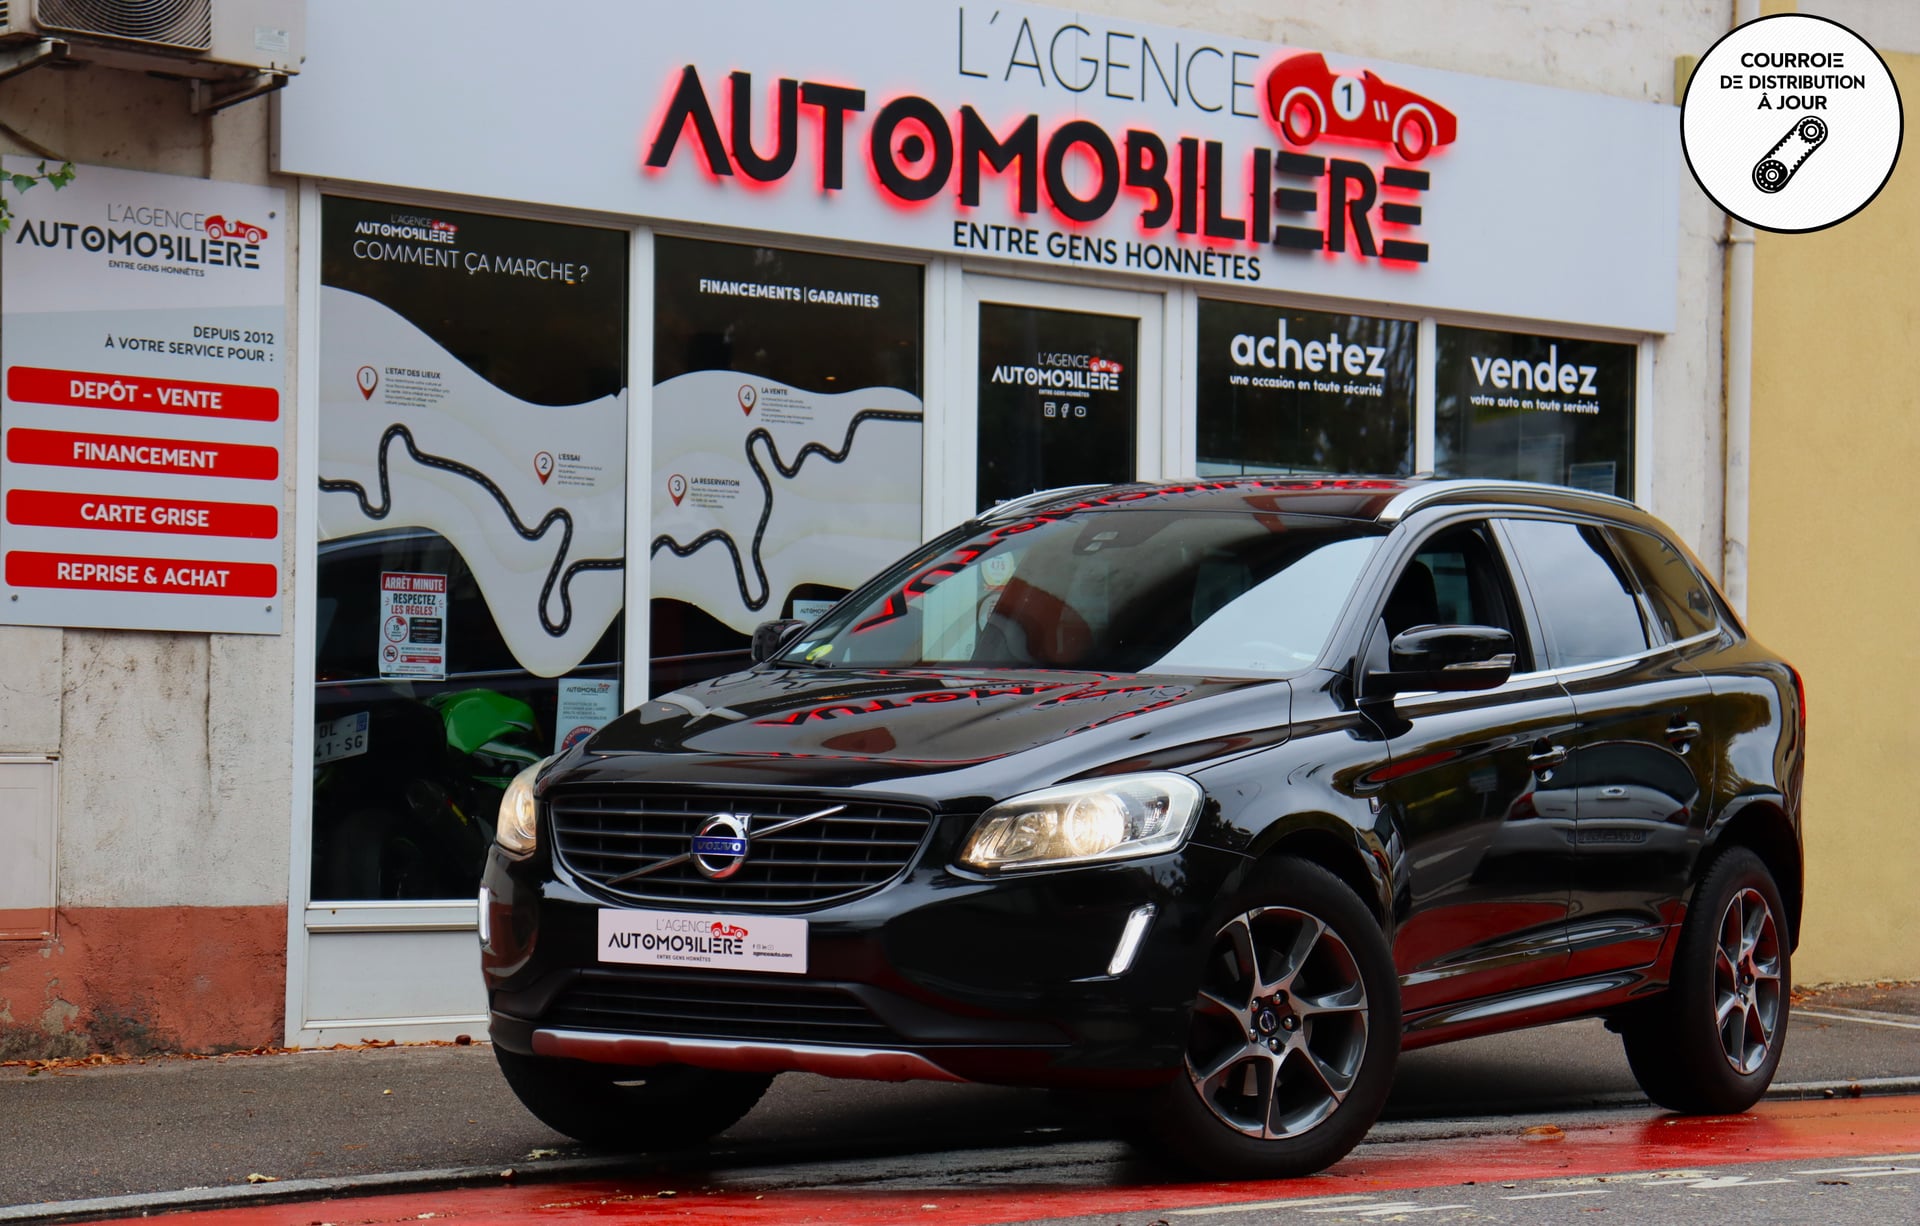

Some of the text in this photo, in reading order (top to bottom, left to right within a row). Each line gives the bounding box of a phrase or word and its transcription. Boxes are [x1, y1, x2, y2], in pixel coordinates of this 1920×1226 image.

[959, 6, 1260, 119] L'AGENCE
[107, 203, 205, 232] L'AGENCE
[16, 219, 260, 269] AUTOMOBILIERE
[953, 221, 1261, 281] ENTRE GENS HONNÊTES
[108, 260, 205, 277] ENTRE GENS HONNÊTES
[353, 239, 589, 282] COMMENT ÇA MARCHE ?
[700, 279, 879, 309] FINANCEMENTS GARANTIES
[193, 326, 274, 345] DEPUIS 2012
[104, 334, 114, 348] À
[119, 337, 164, 352] VOTRE
[168, 342, 224, 358] SERVICE
[228, 347, 265, 362] POUR
[1230, 319, 1386, 377] achetez
[1038, 352, 1089, 368] L'AGENCE
[1471, 344, 1597, 395] vendez
[407, 369, 420, 377] DES
[421, 371, 440, 379] LIEUX
[992, 365, 1119, 391] AUTOMOBILIERE
[70, 379, 139, 402] DEPÔT
[156, 387, 222, 410] VENTE
[744, 391, 751, 401] 4
[1230, 375, 1382, 397] une occasion en toute sécurité
[1470, 395, 1495, 407] votre
[1498, 396, 1519, 408] auto
[1522, 400, 1533, 409] en
[1536, 399, 1560, 412] toute
[73, 441, 218, 469] FINANCEMENT
[541, 457, 548, 469] 2
[674, 480, 681, 491] 3
[80, 503, 209, 527] CARTE GRISE
[57, 562, 230, 588] REPRISE & ACHAT
[385, 575, 443, 591] ARRÊT MINUTE
[391, 605, 404, 615] LES
[393, 593, 436, 605] RESPECTEZ
[697, 841, 741, 851] VOLVO
[656, 918, 711, 934] L'AGENCE
[608, 932, 744, 955] AUTOMOBILIERE
